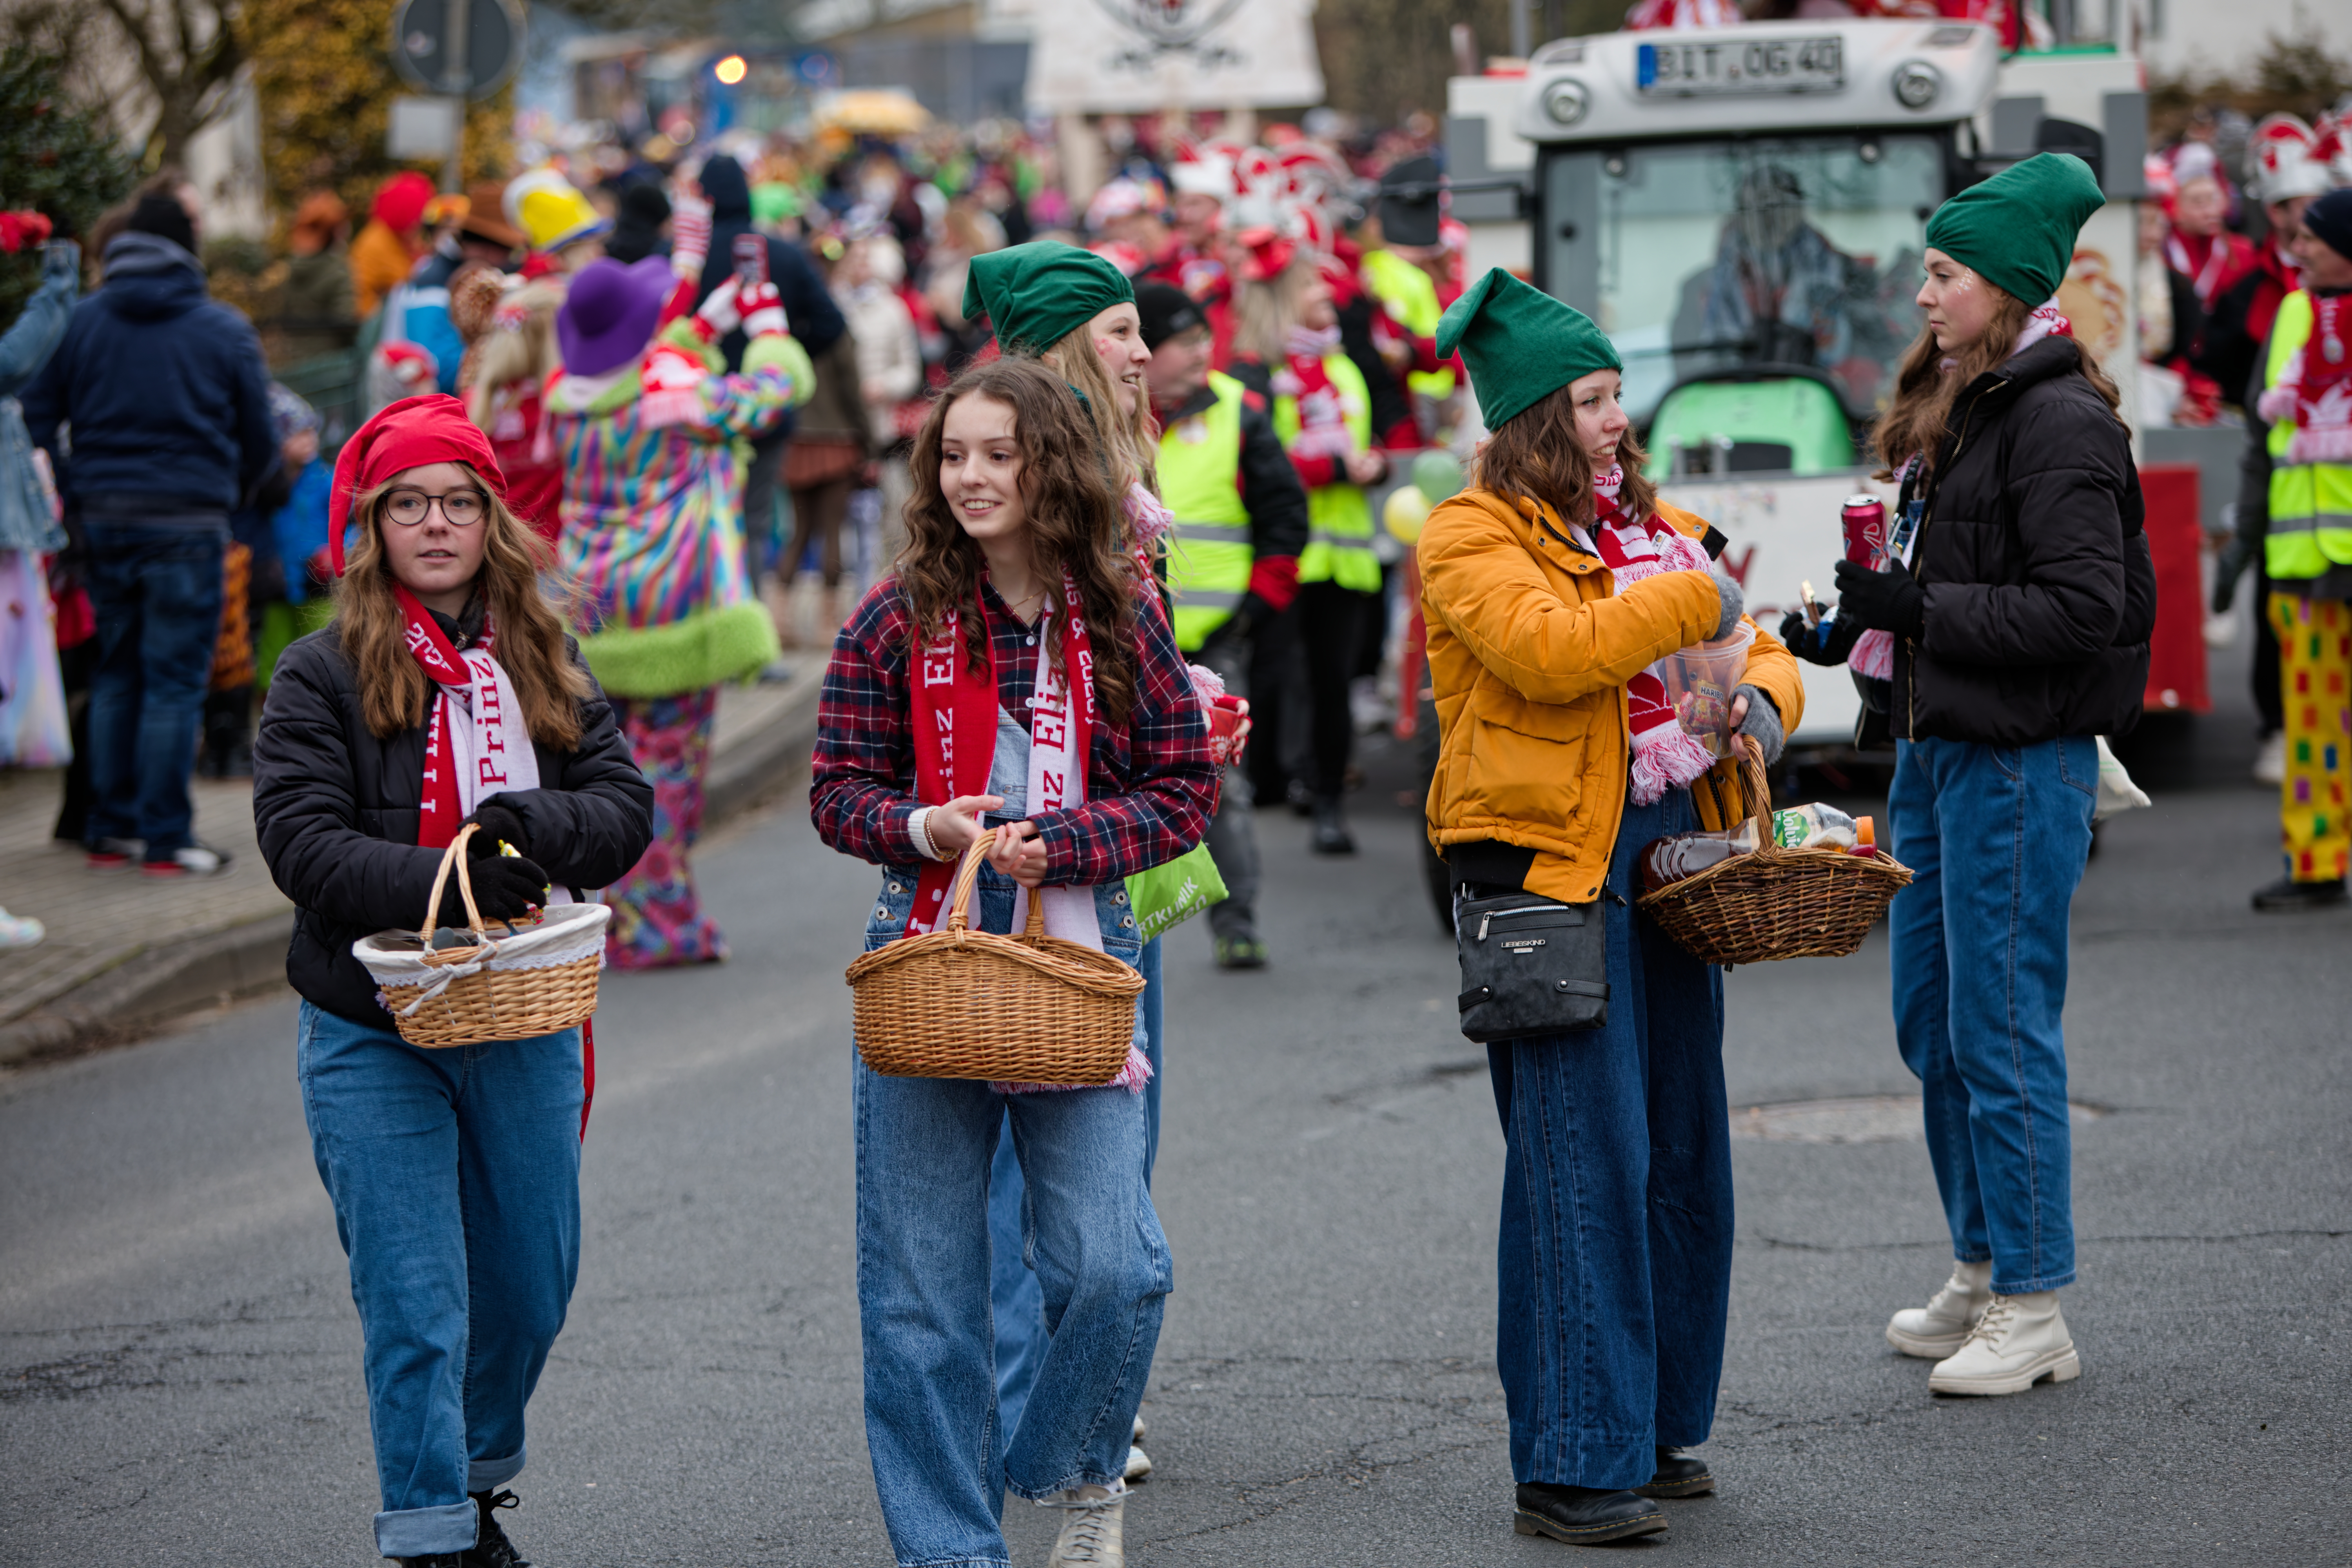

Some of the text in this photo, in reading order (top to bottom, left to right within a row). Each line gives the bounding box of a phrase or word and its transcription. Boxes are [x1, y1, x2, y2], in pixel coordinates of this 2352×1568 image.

[1657, 44, 1723, 79] BIT
[1700, 686, 1724, 701] HARIBO
[470, 657, 507, 787] Prinz
[1139, 876, 1198, 932] RTKLINIK
[1501, 939, 1546, 948] LIEBESKIND
